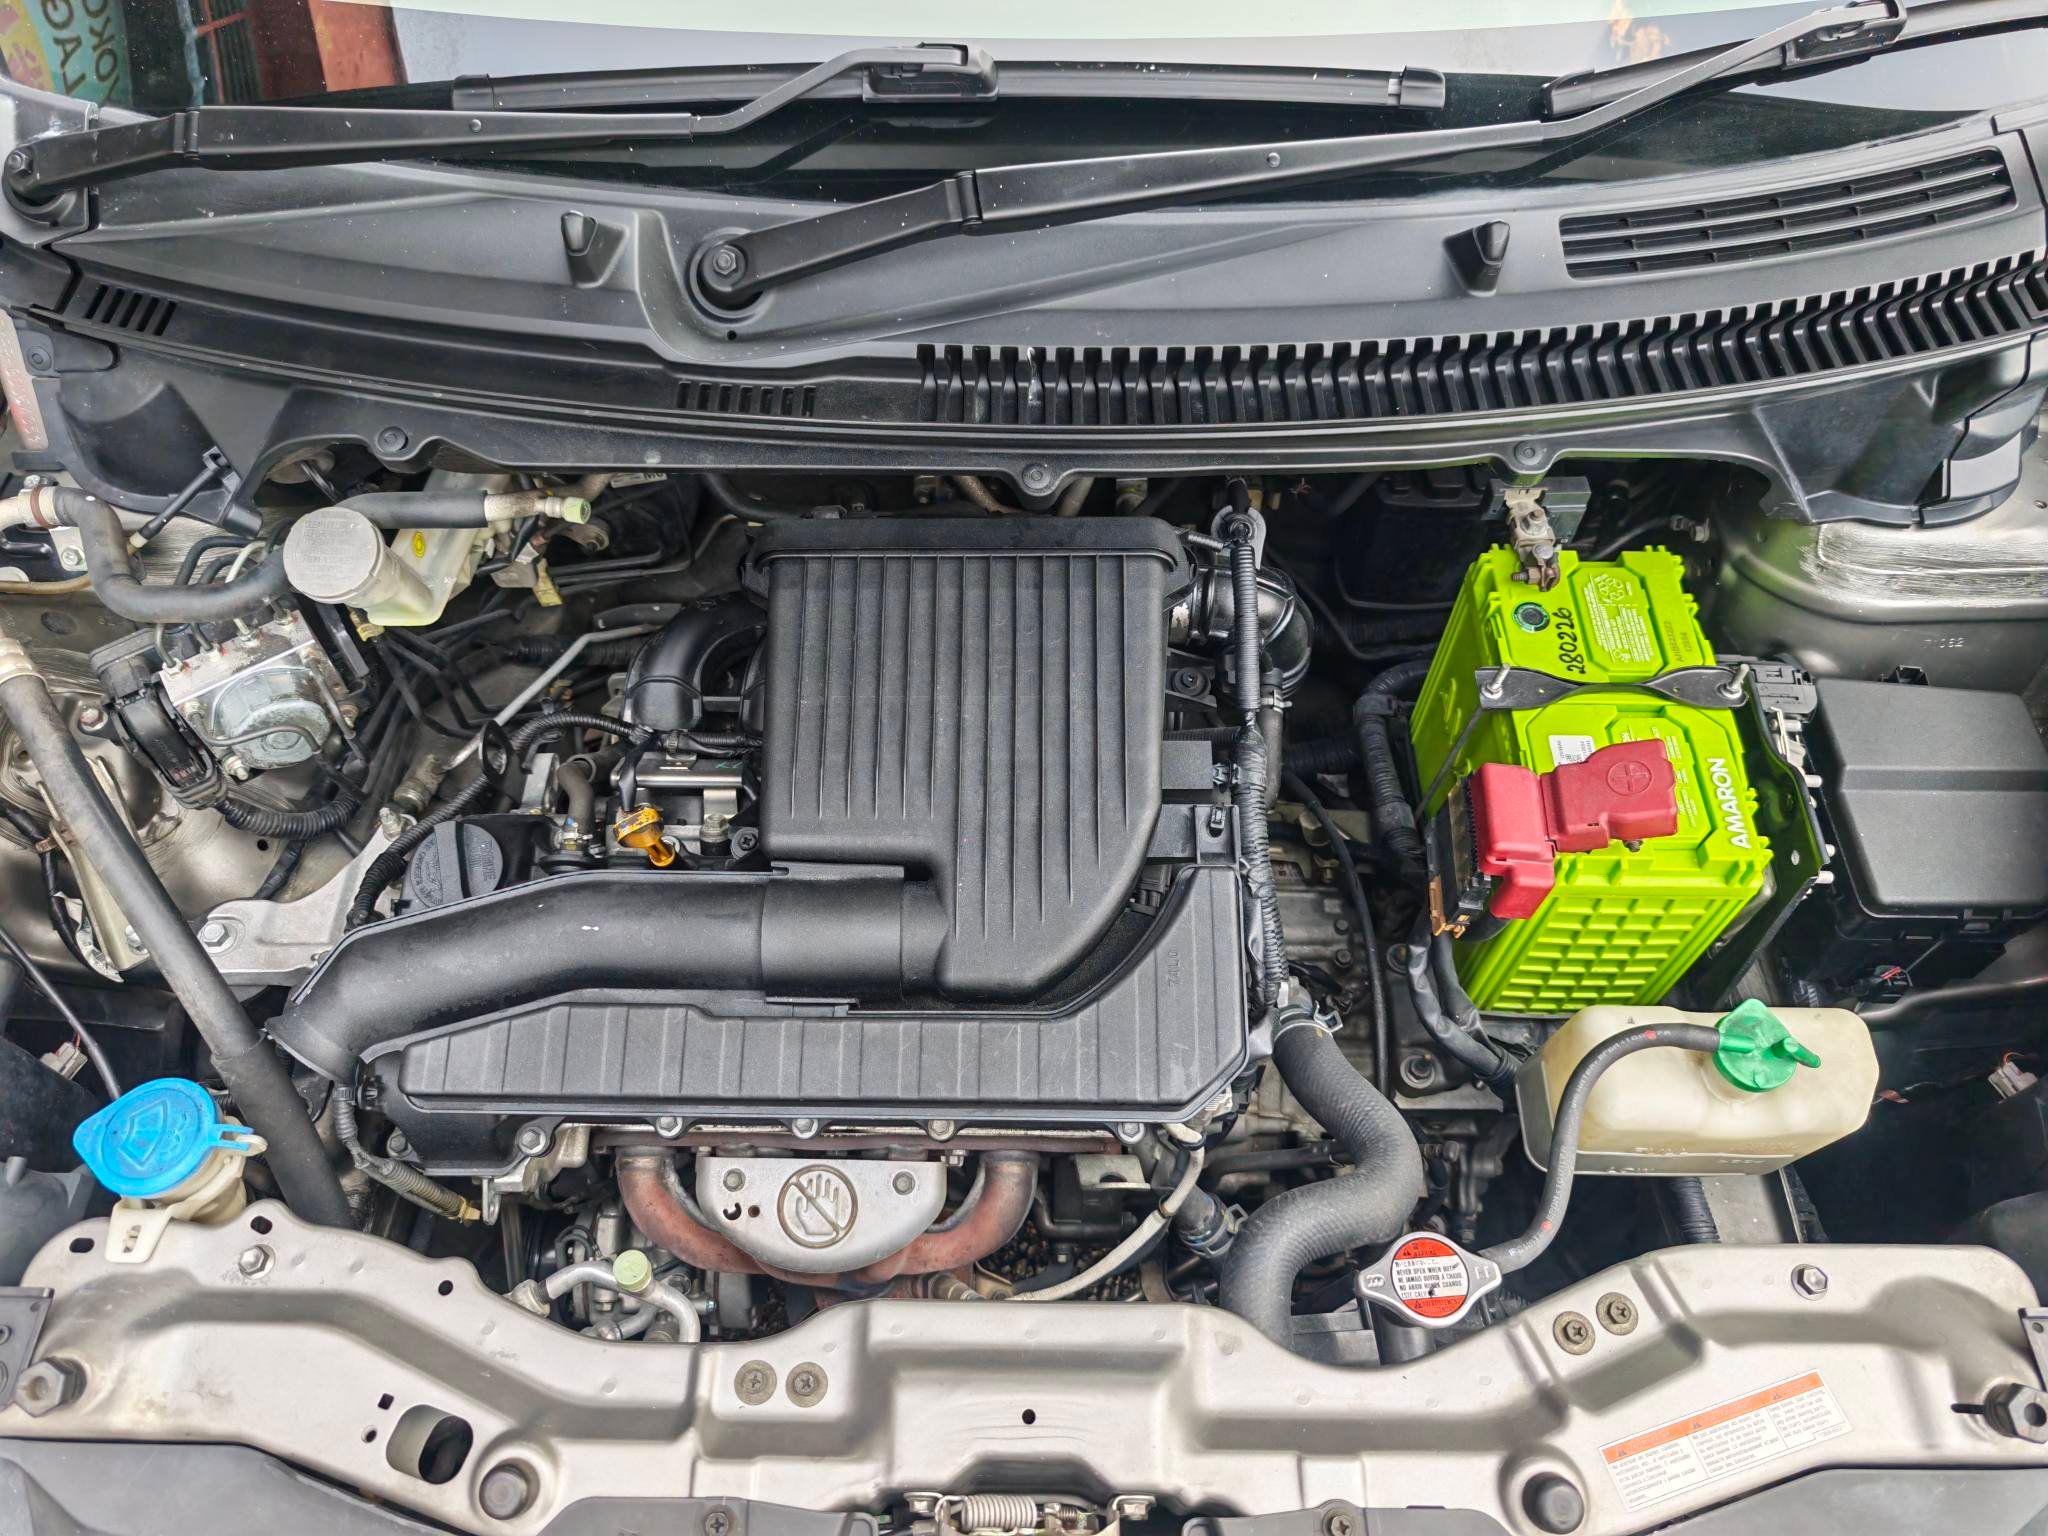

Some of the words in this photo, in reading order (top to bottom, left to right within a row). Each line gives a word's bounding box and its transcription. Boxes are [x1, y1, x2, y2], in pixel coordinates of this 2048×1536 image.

[1552, 608, 1586, 674] 280226
[1707, 757, 1752, 849] AMARON
[1413, 1267, 1427, 1275] OPEN
